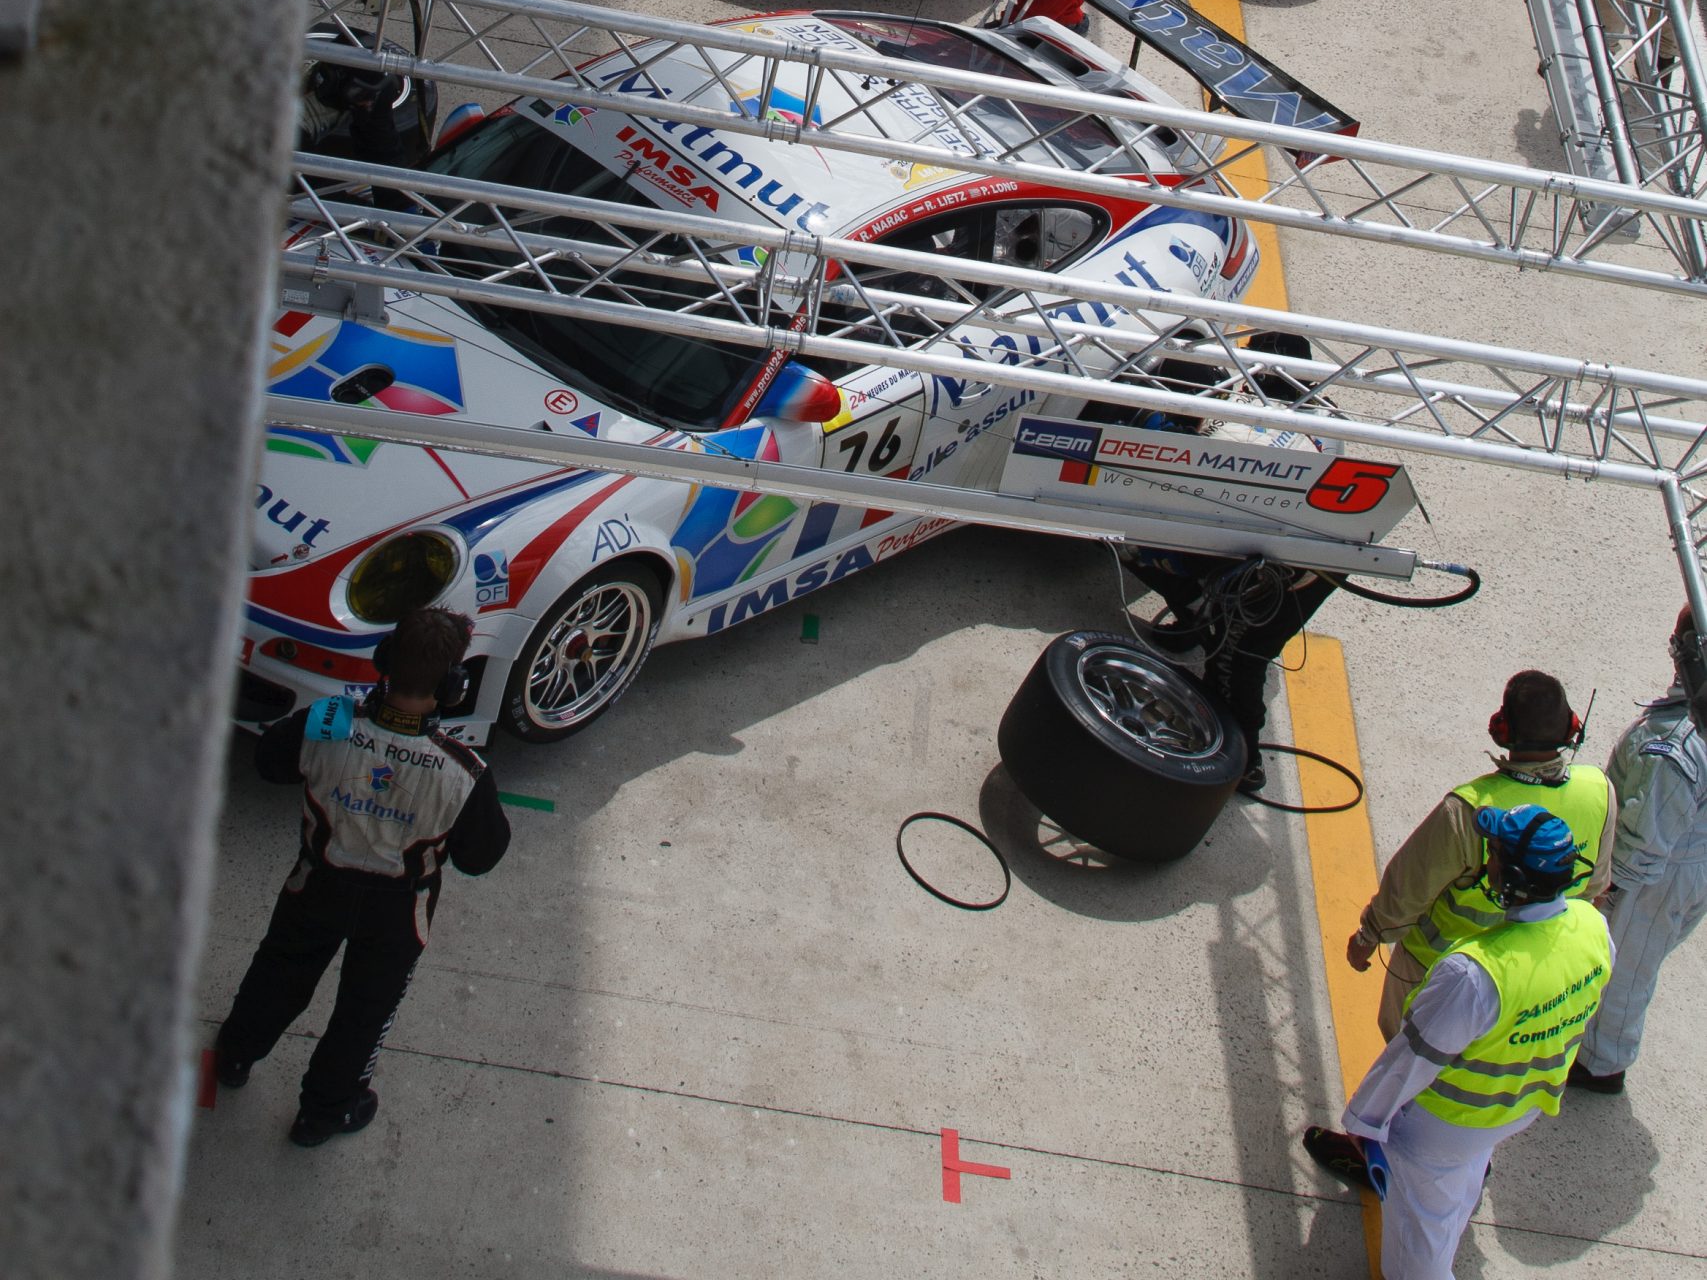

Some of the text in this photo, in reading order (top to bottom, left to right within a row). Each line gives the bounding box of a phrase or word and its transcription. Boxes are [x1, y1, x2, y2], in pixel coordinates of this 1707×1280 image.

[614, 149, 697, 205] Performance
[615, 125, 720, 213] IMSA
[871, 209, 909, 233] NARAC
[923, 200, 937, 212] R.
[938, 191, 967, 208] LIETZ
[979, 185, 990, 196] P.
[990, 181, 1018, 194] LONG
[849, 390, 868, 411] 24
[866, 378, 889, 401] HEURES
[889, 373, 899, 387] DU
[839, 416, 902, 473] 76
[1020, 428, 1403, 514] team ORECA MATMUT 5
[1103, 471, 1303, 509] We race harder
[707, 543, 876, 635] IMSA
[320, 700, 339, 740] LE MANS
[385, 743, 445, 770] ROUEN
[331, 786, 415, 826] Matmut
[1514, 1004, 1540, 1026] 24
[1542, 987, 1569, 1013] HEURES
[1571, 979, 1582, 995] DU
